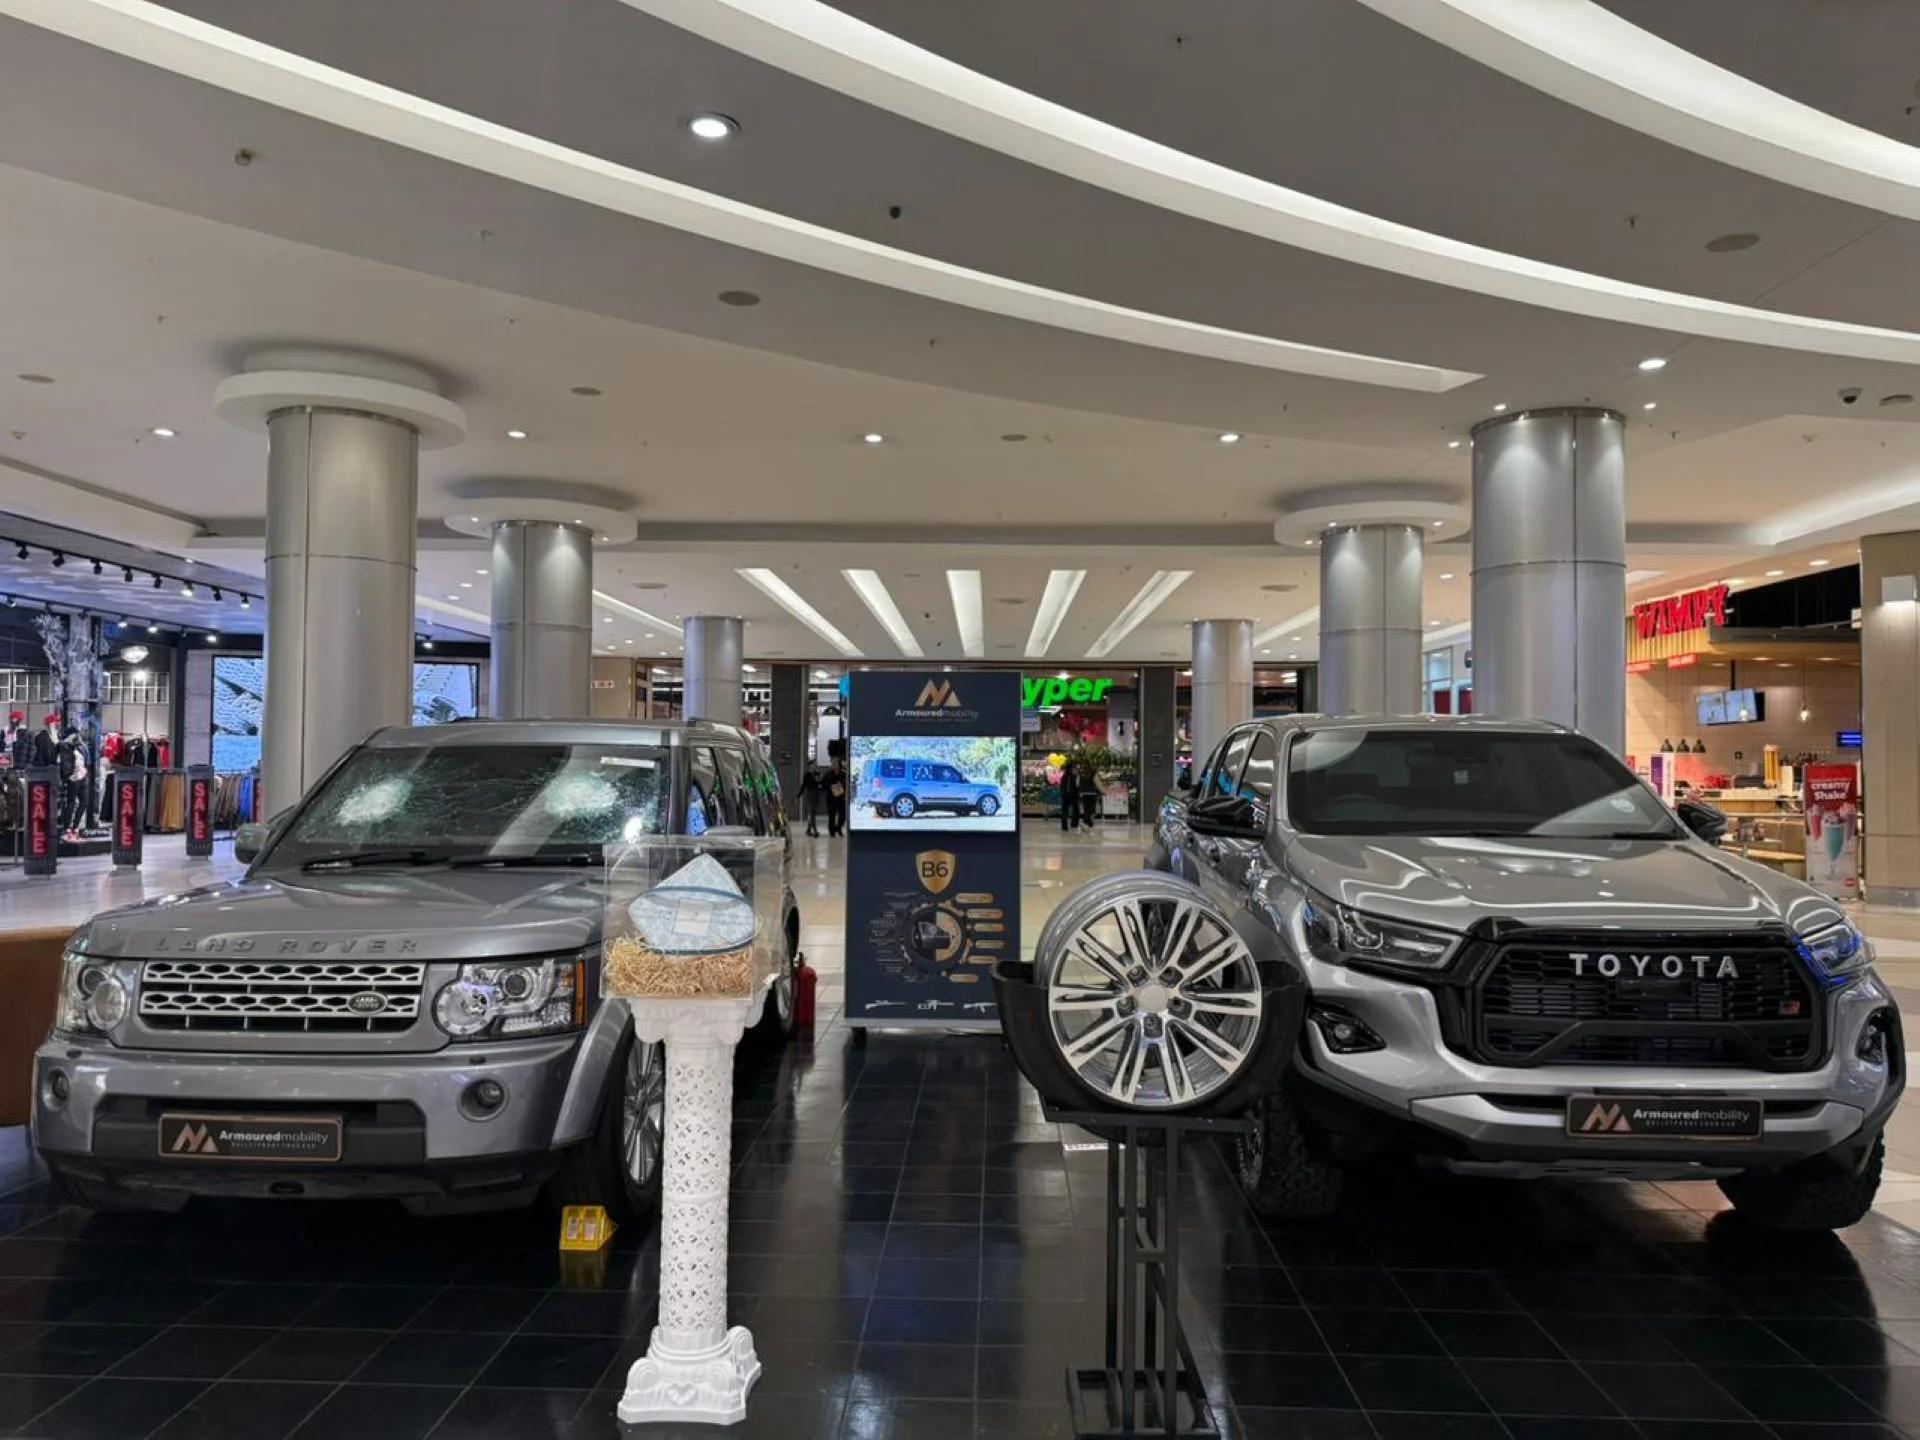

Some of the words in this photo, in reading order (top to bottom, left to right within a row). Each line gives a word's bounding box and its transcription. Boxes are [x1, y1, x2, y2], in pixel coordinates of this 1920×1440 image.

[1633, 584, 1729, 640] WIMPY
[1814, 790, 1847, 801] Shake
[31, 786, 46, 853] SALE
[121, 786, 134, 846] SALE
[194, 783, 206, 839] SALE
[922, 861, 948, 877] B6
[155, 938, 256, 953] LAND
[278, 937, 419, 954] ROVER
[1569, 953, 1739, 979] TOYOTA
[1633, 1108, 1750, 1122] Armouredmobility
[219, 1130, 329, 1144] Armouredmobility
